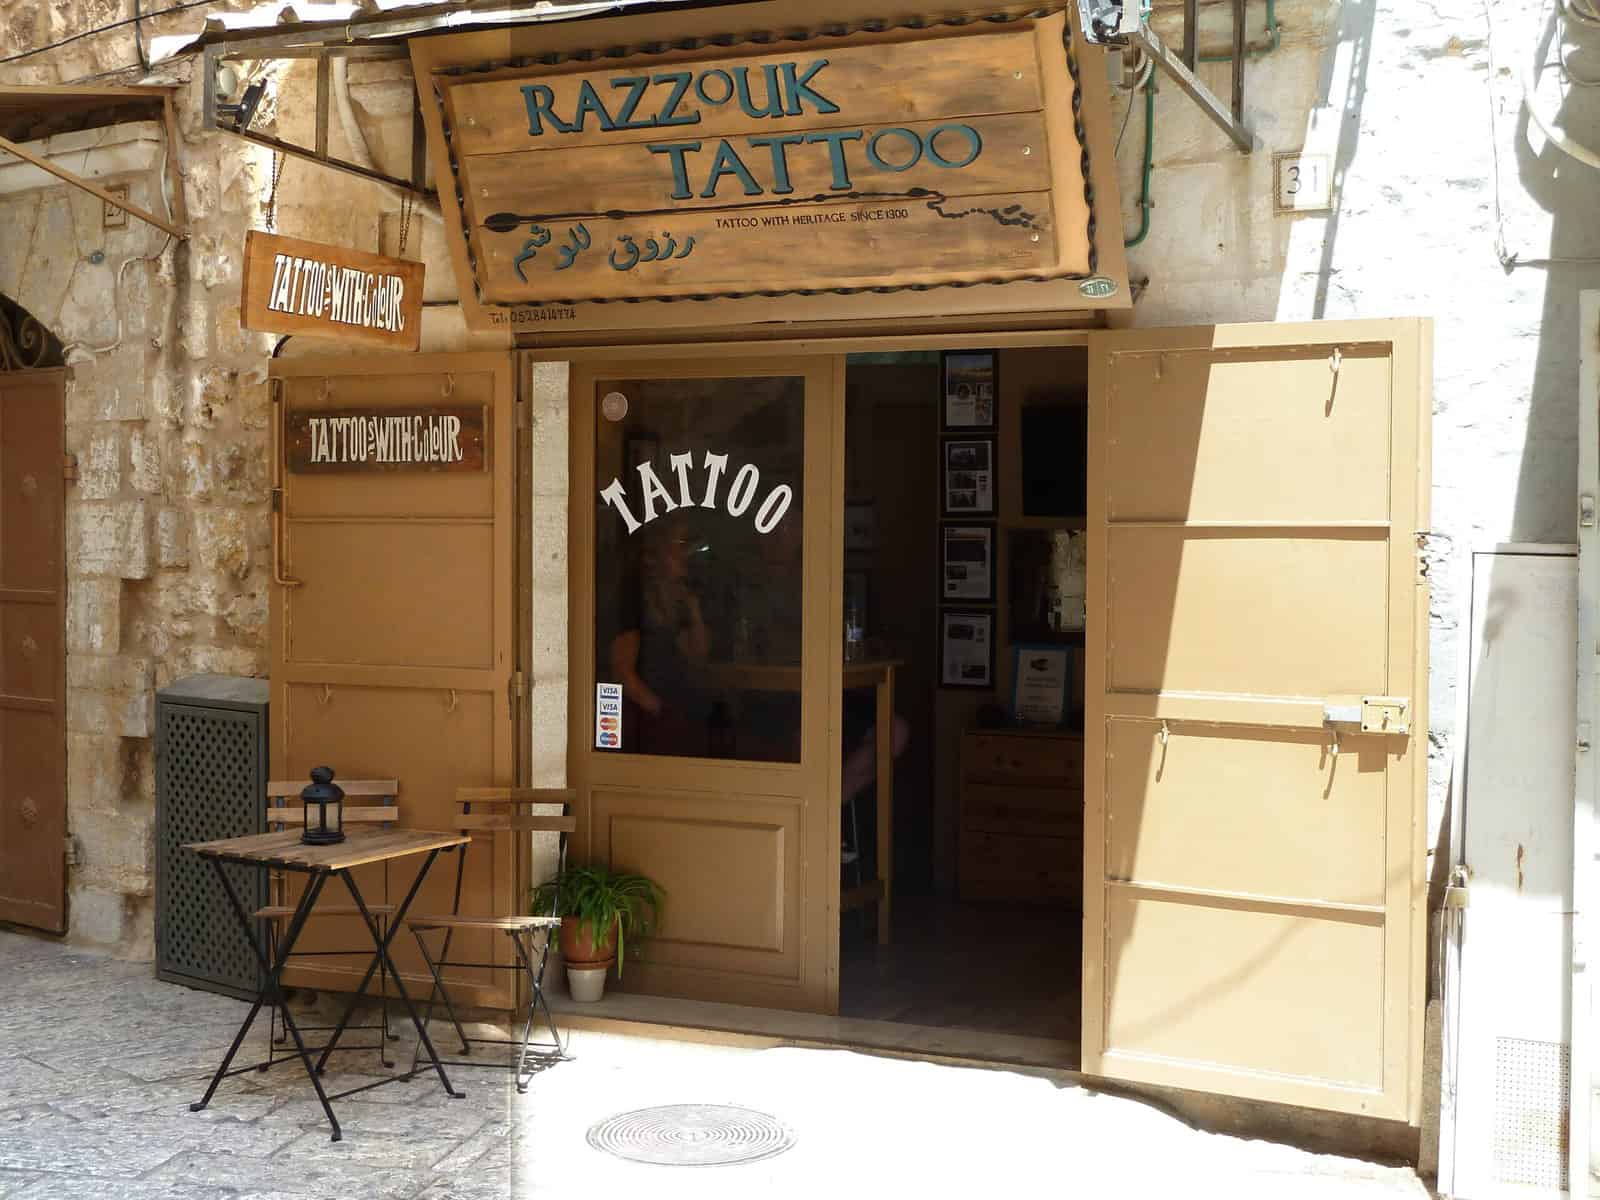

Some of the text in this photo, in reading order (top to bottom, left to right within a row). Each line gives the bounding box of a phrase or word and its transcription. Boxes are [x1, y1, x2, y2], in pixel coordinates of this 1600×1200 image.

[520, 59, 840, 136] RAZZOUK
[646, 124, 983, 199] TATTOO
[1287, 165, 1318, 194] 31
[715, 208, 909, 229] TATTOO WITH HERITAGE SINCE 1300
[514, 222, 696, 284] رزوق للوشم
[600, 450, 793, 535] TATTOO
[602, 687, 618, 695] VISA
[602, 703, 618, 711] VISA
